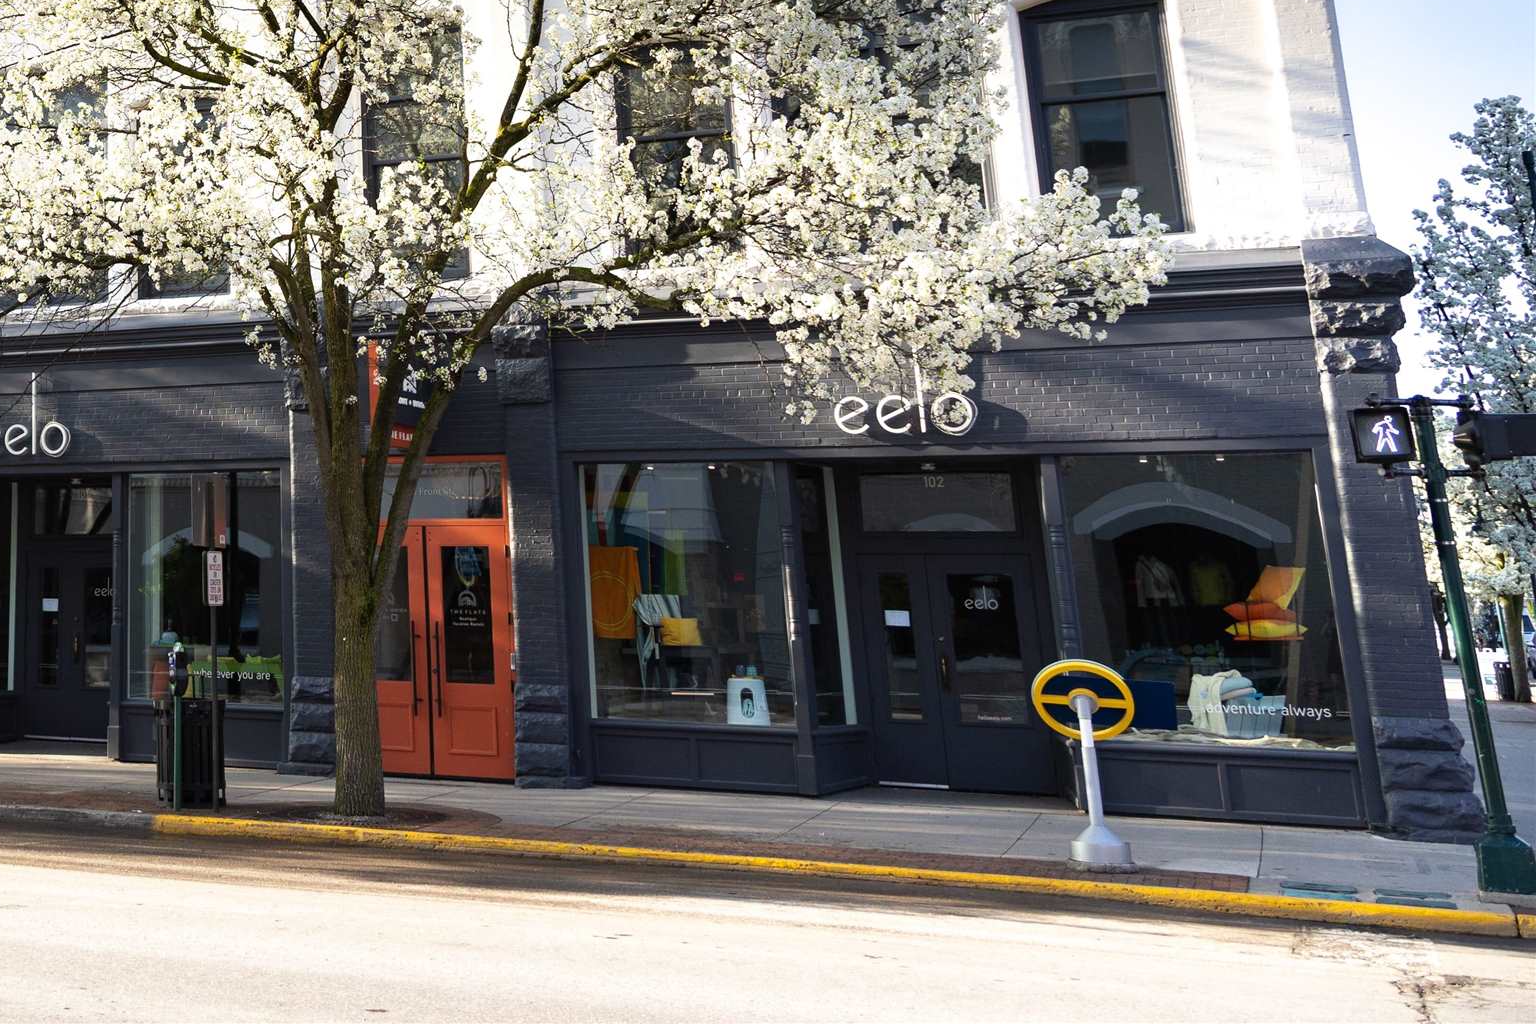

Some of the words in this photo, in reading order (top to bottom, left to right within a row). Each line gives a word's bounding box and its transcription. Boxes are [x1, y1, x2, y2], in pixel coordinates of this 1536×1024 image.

[834, 344, 978, 436] eelo
[923, 476, 945, 488] 102
[964, 585, 998, 610] eelo
[237, 671, 254, 682] you
[256, 672, 271, 681] are
[1206, 702, 1276, 716] adventure
[1281, 703, 1332, 720] always
